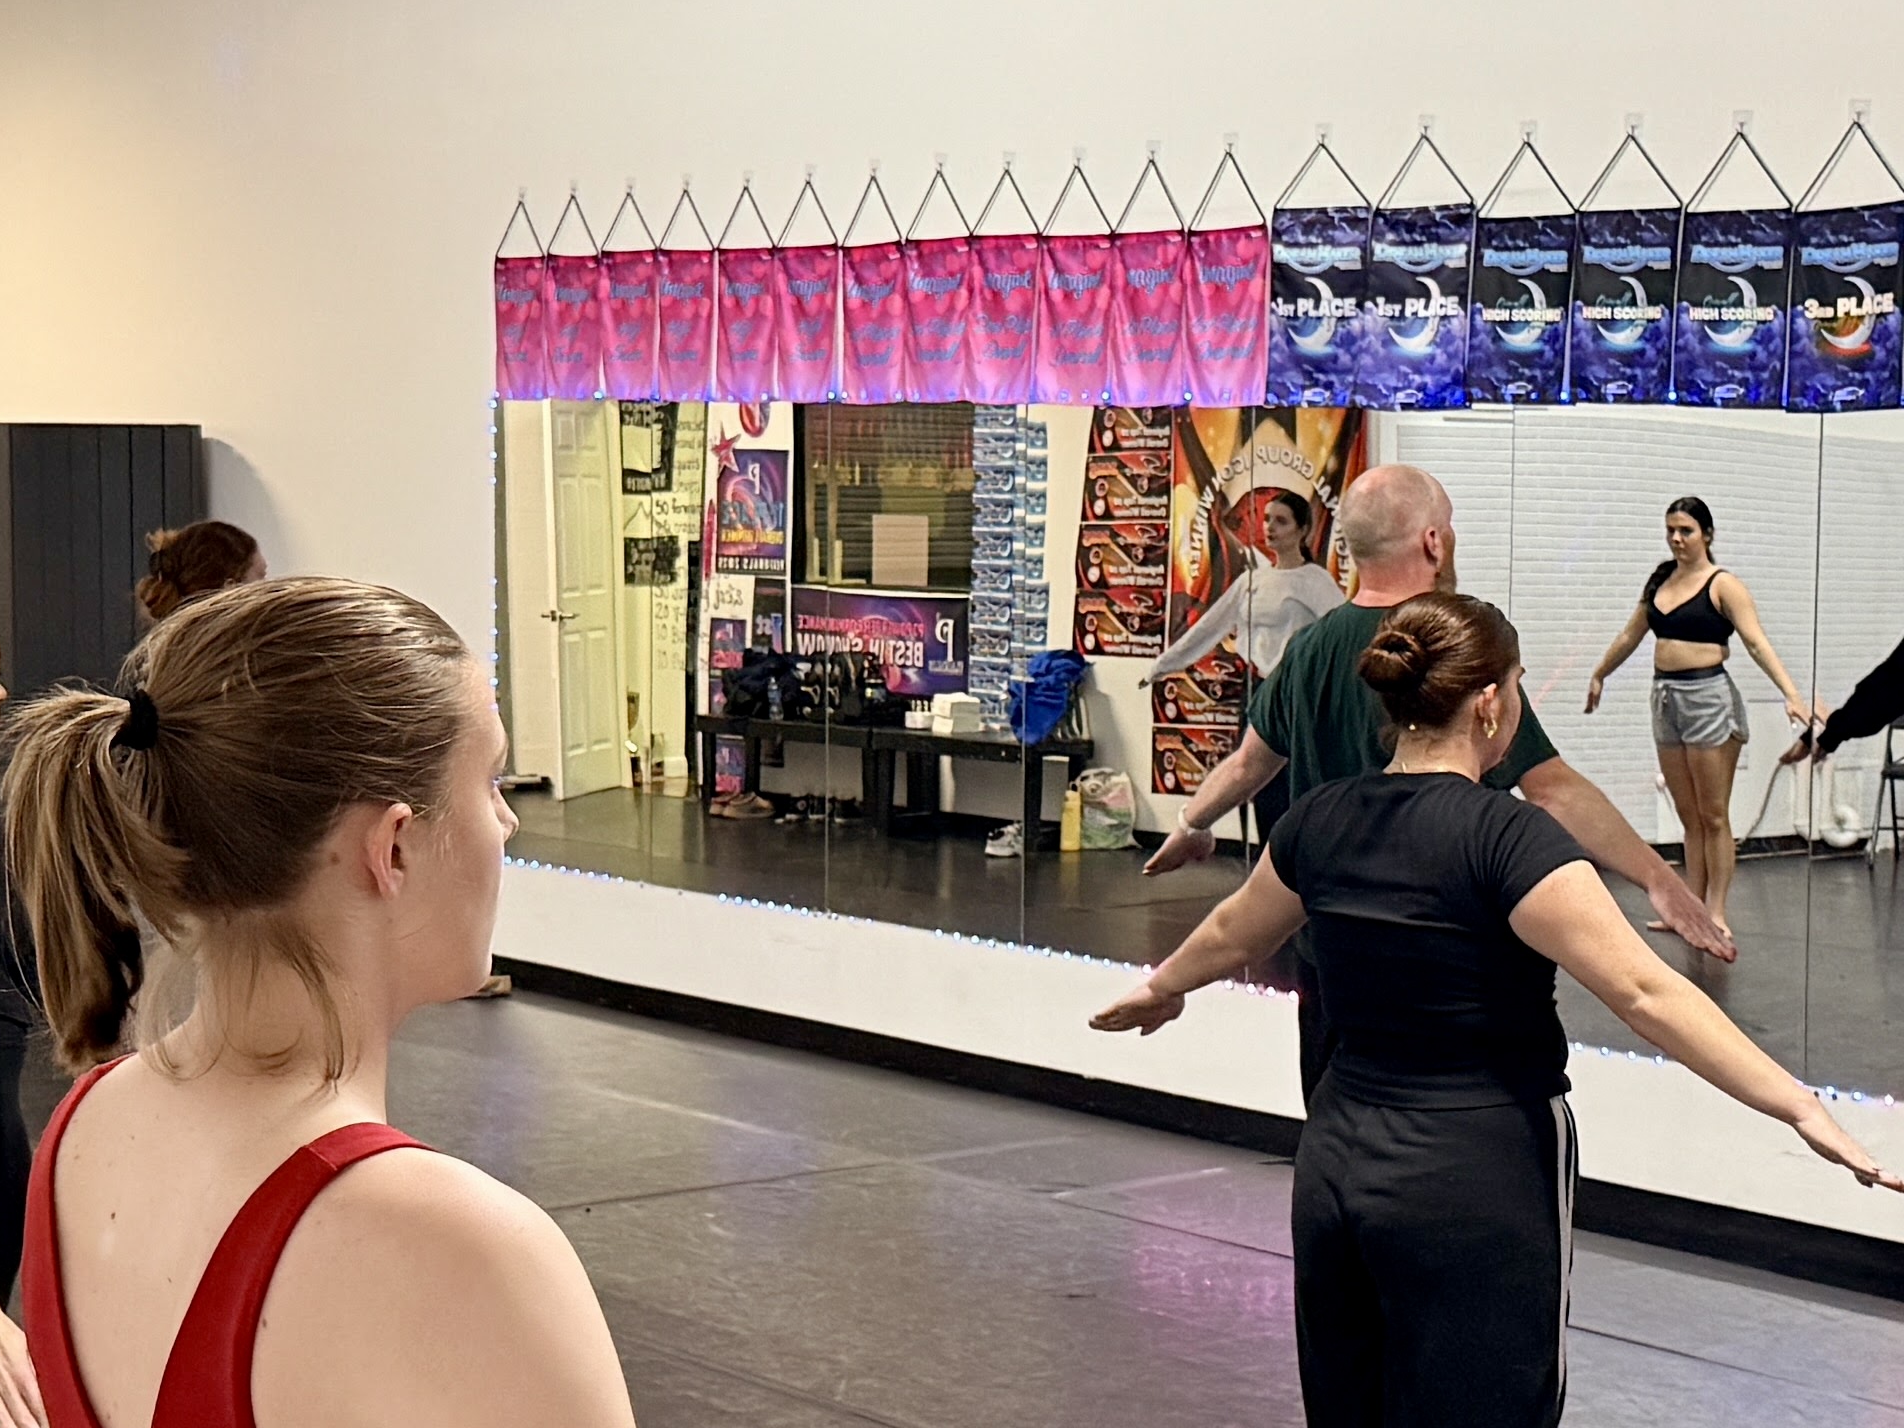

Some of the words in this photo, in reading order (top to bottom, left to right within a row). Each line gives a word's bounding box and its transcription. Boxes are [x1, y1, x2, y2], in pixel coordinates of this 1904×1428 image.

[1298, 298, 1356, 317] PLACE
[1405, 295, 1458, 317] PLACE
[1837, 293, 1894, 317] PLACE
